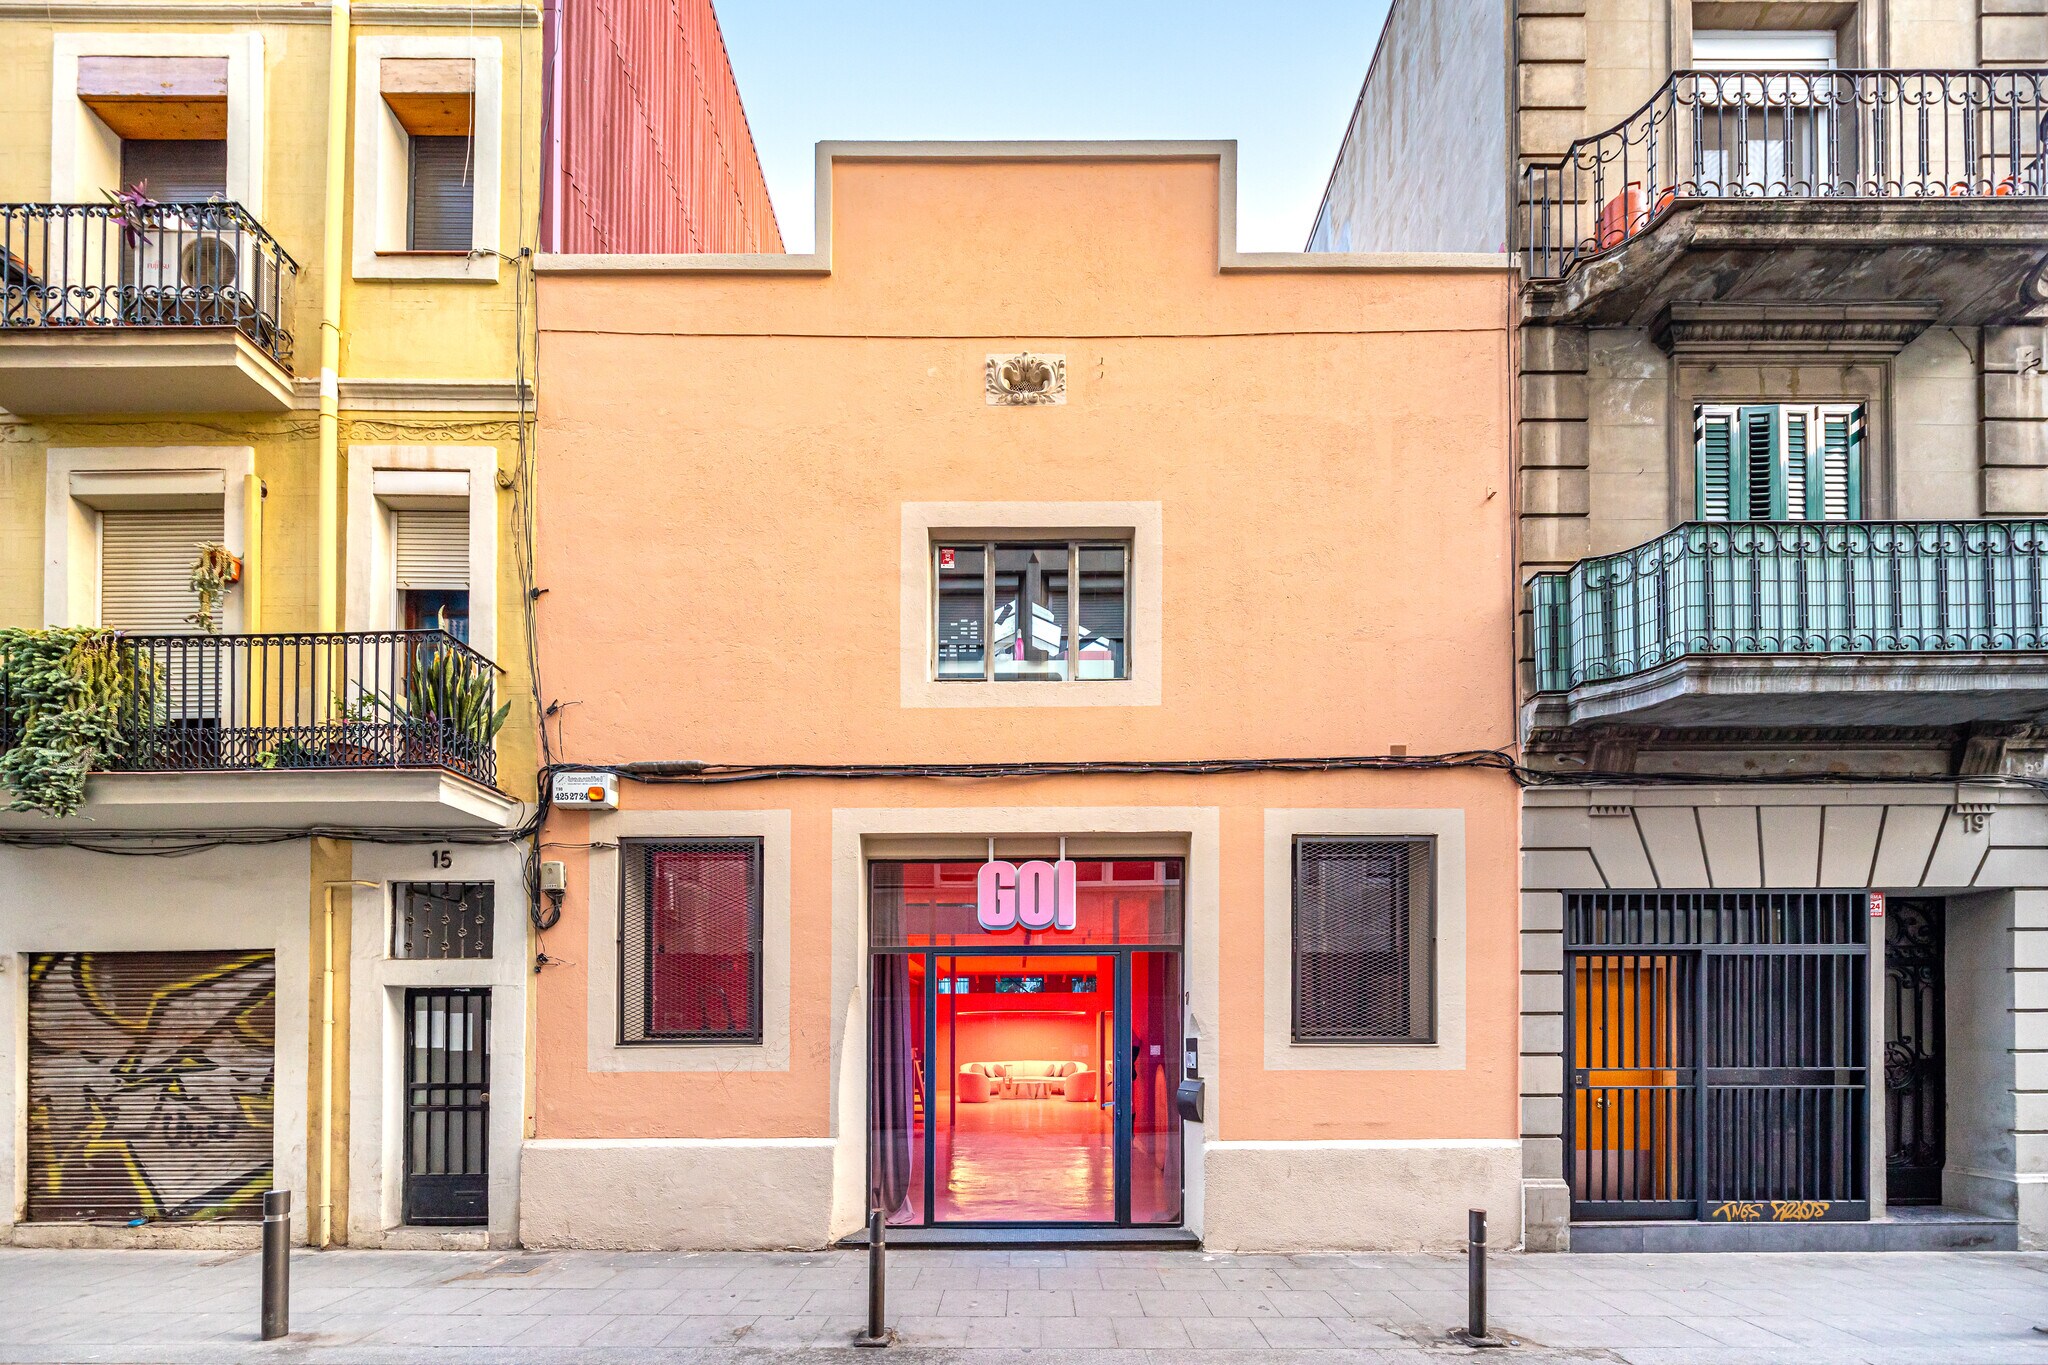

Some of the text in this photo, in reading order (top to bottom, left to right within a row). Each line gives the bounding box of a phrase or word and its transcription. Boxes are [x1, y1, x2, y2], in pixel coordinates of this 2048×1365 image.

[146, 260, 170, 270] FUJISU
[1962, 814, 1984, 834] 19
[432, 850, 453, 869] 15
[978, 860, 1077, 930] GOI
